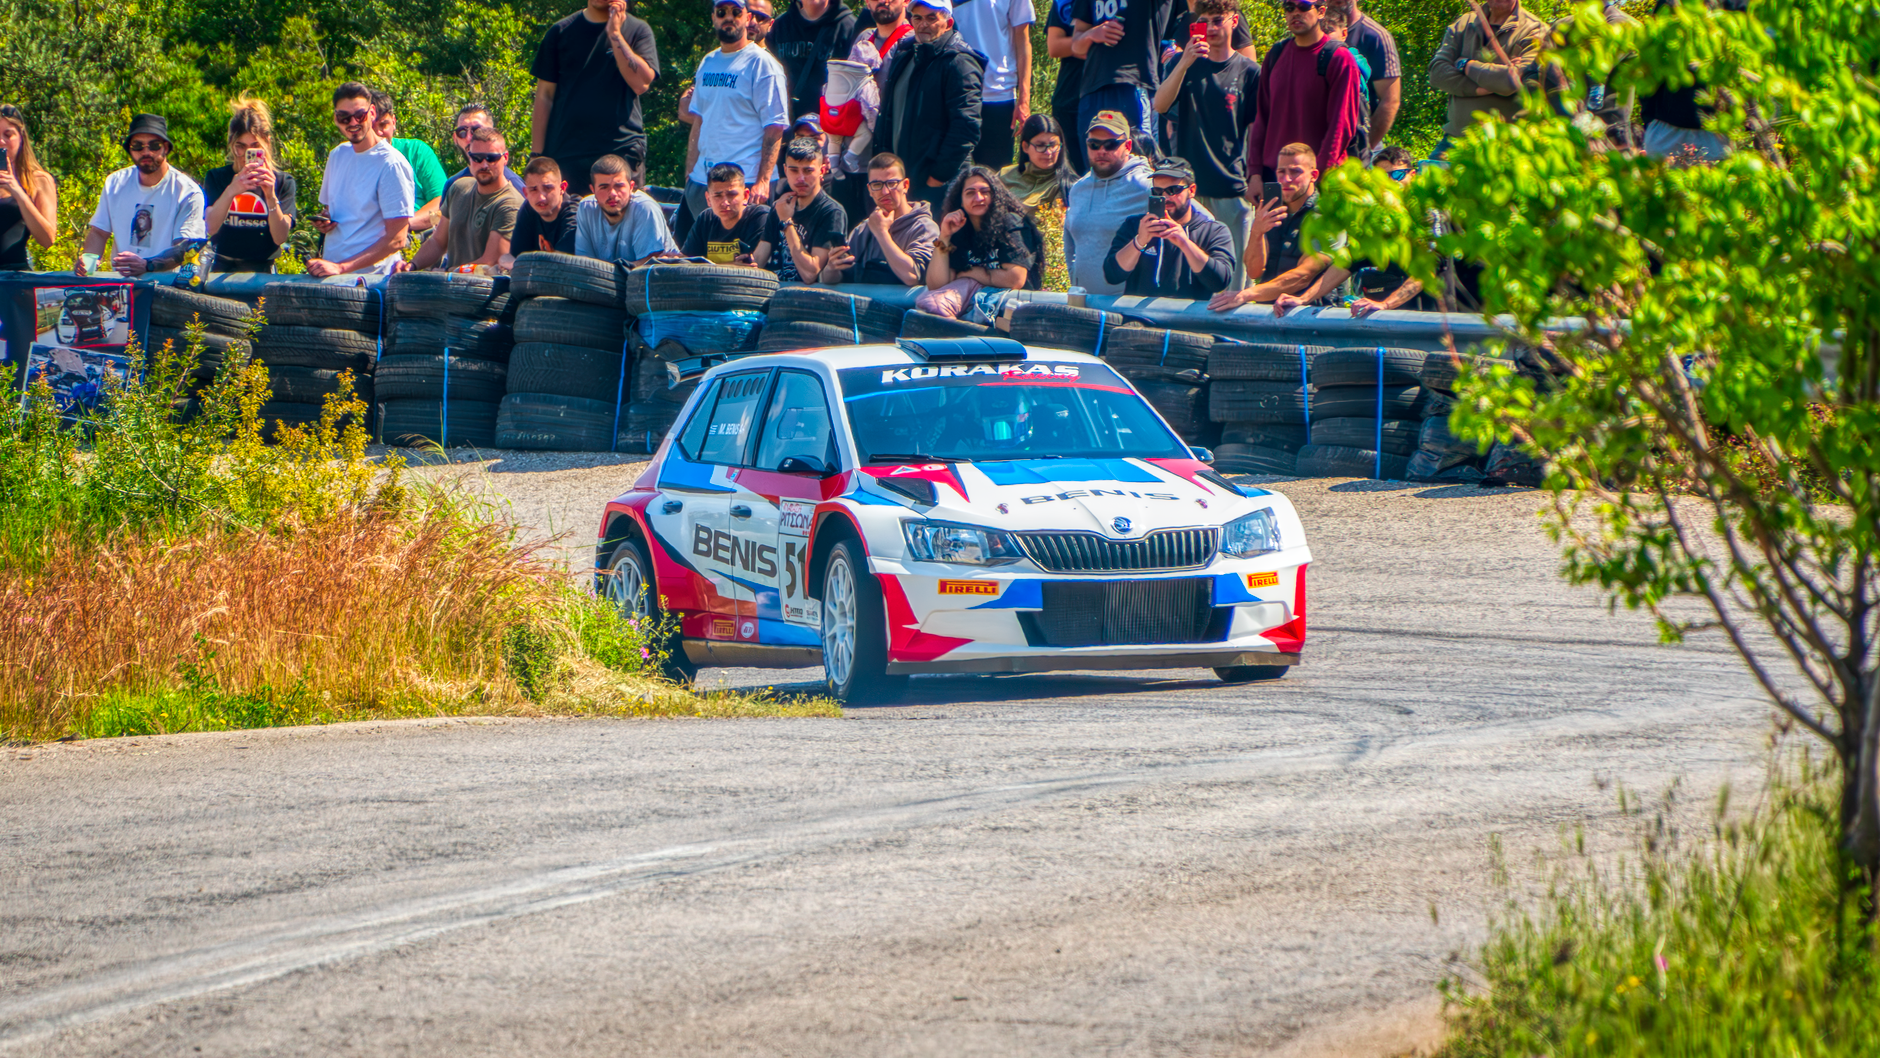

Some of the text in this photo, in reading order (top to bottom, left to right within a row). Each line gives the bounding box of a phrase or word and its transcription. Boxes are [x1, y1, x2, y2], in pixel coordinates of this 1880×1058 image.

[223, 215, 267, 227] ellesse
[881, 364, 1079, 384] KORAKAS
[1001, 369, 1081, 383] Racing
[1020, 489, 1180, 505] BENIS
[693, 523, 777, 578] BENIS
[785, 542, 808, 600] 51
[1248, 572, 1279, 587] PIRELLI
[940, 581, 997, 594] PIRELLI
